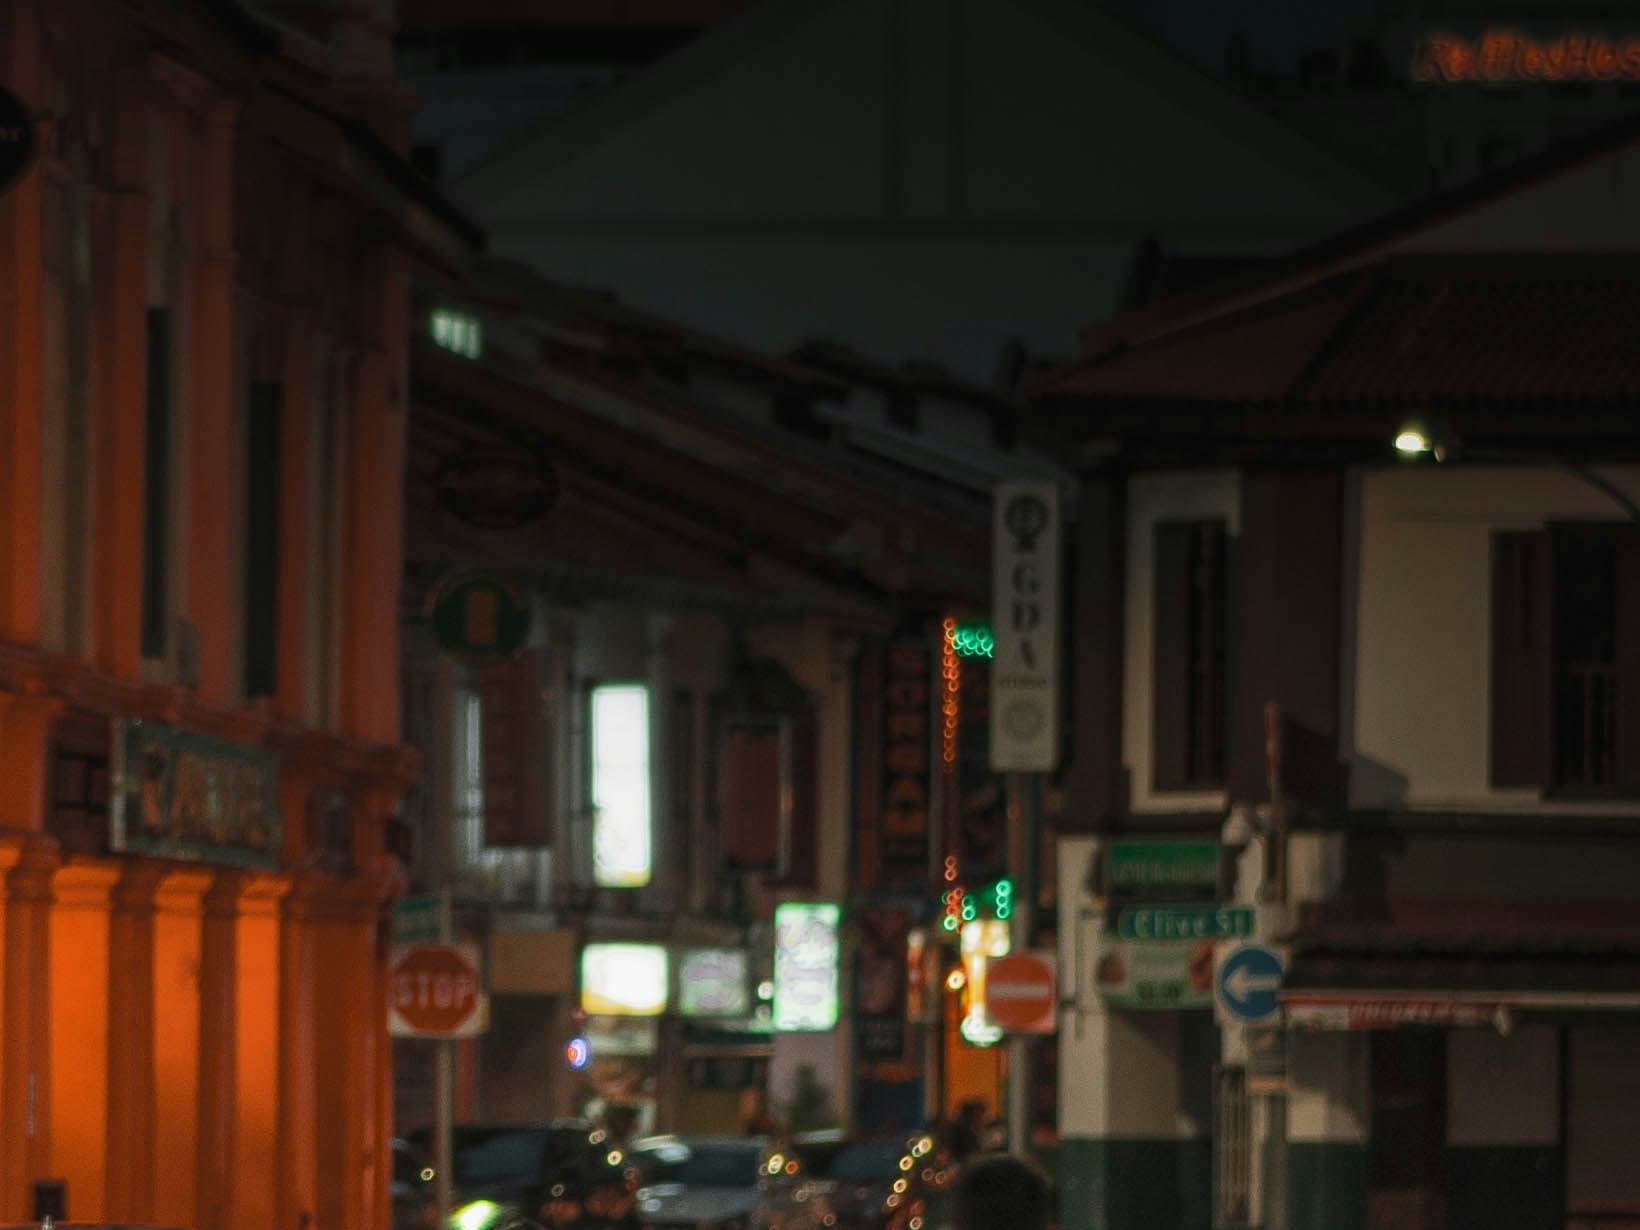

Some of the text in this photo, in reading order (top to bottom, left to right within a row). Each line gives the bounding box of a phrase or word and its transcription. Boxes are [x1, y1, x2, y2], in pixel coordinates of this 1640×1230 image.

[1134, 908, 1248, 938] Clive St
[395, 971, 478, 1009] STOP
